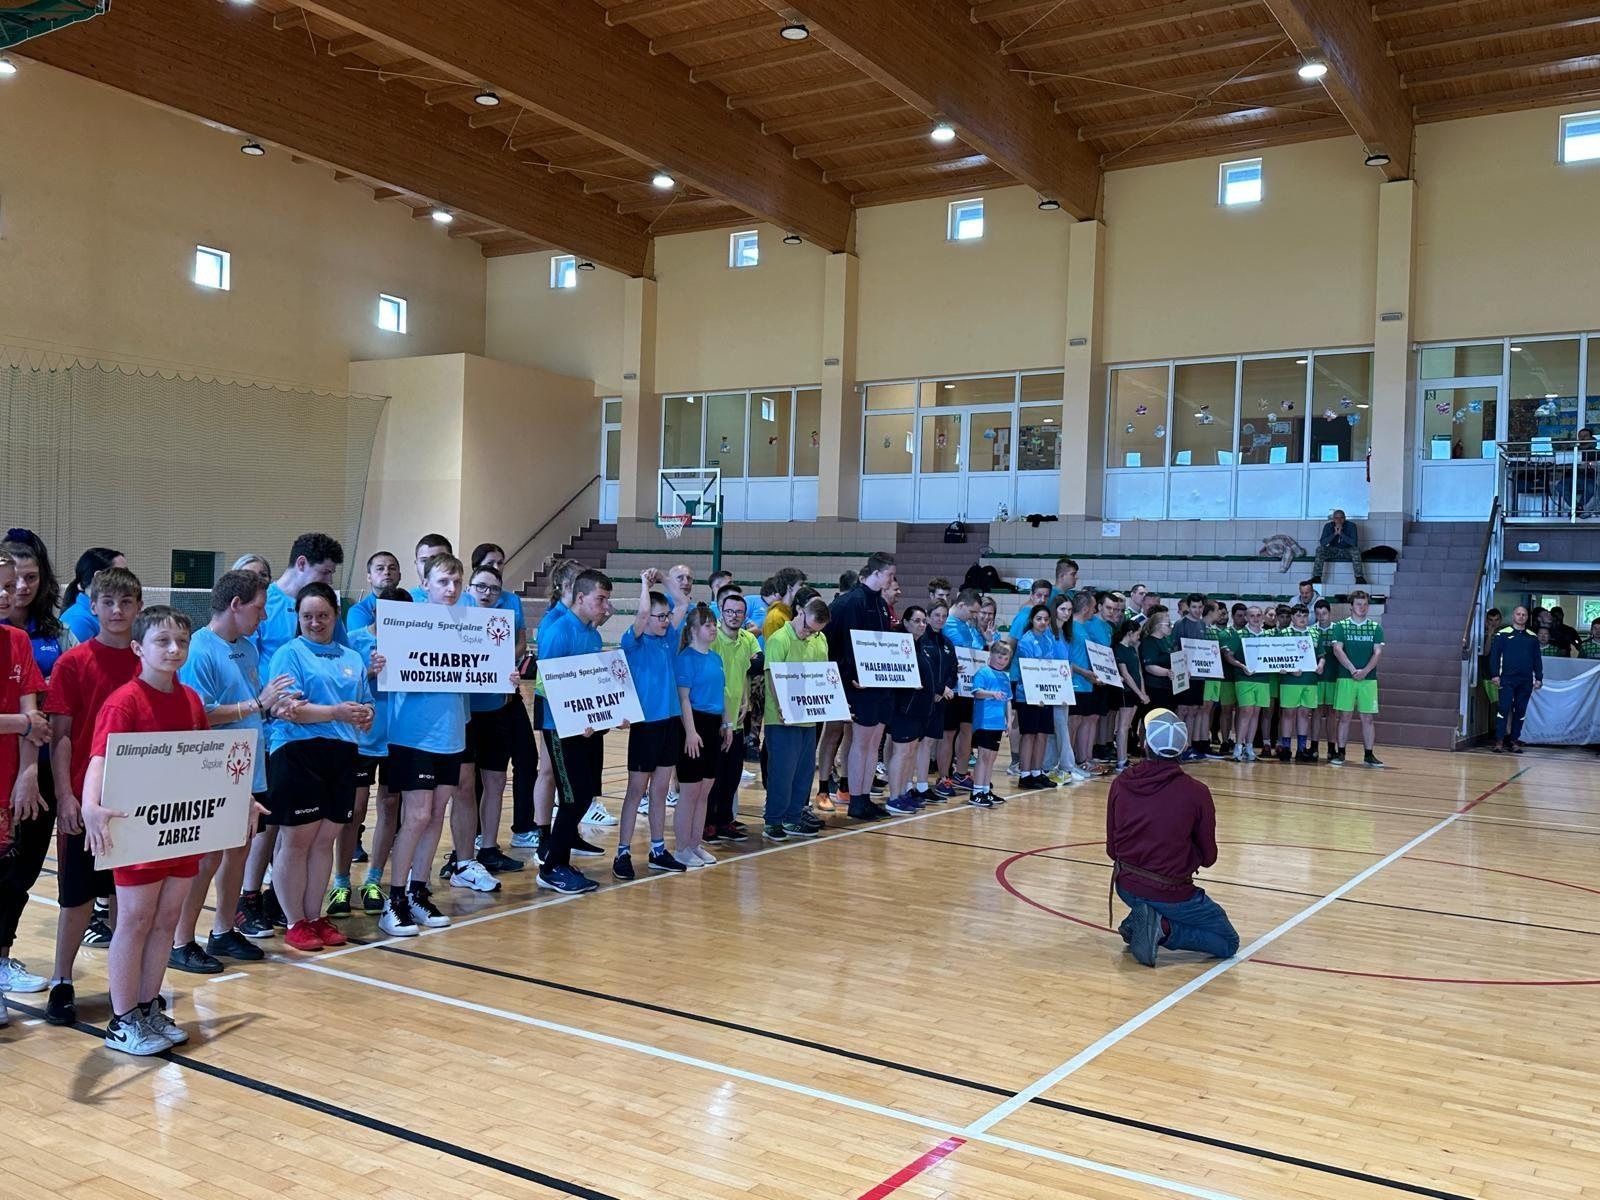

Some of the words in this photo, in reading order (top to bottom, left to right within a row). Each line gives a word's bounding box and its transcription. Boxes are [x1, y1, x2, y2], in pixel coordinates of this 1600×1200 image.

[383, 617, 434, 630] Olimpiady
[437, 621, 483, 632] Specjalne
[408, 652, 490, 668] "CHABRY"
[1257, 655, 1304, 663] "ANIMUSZ"
[400, 670, 462, 683] WODZISŁAW
[465, 669, 498, 686] ŚLĄSKI
[545, 671, 577, 681] Olimpiady
[578, 666, 608, 677] Specjalne
[564, 697, 595, 713] "FAIR
[595, 691, 625, 708] PLAY"
[791, 694, 834, 706] "PROMYK"
[587, 710, 613, 724] RYBNIK
[116, 742, 172, 757] Olimpiady
[176, 740, 225, 755] Specjalne
[201, 757, 223, 770] Śląskie
[134, 797, 226, 826] "GUMISIE"
[157, 825, 201, 846] ZABRZE
